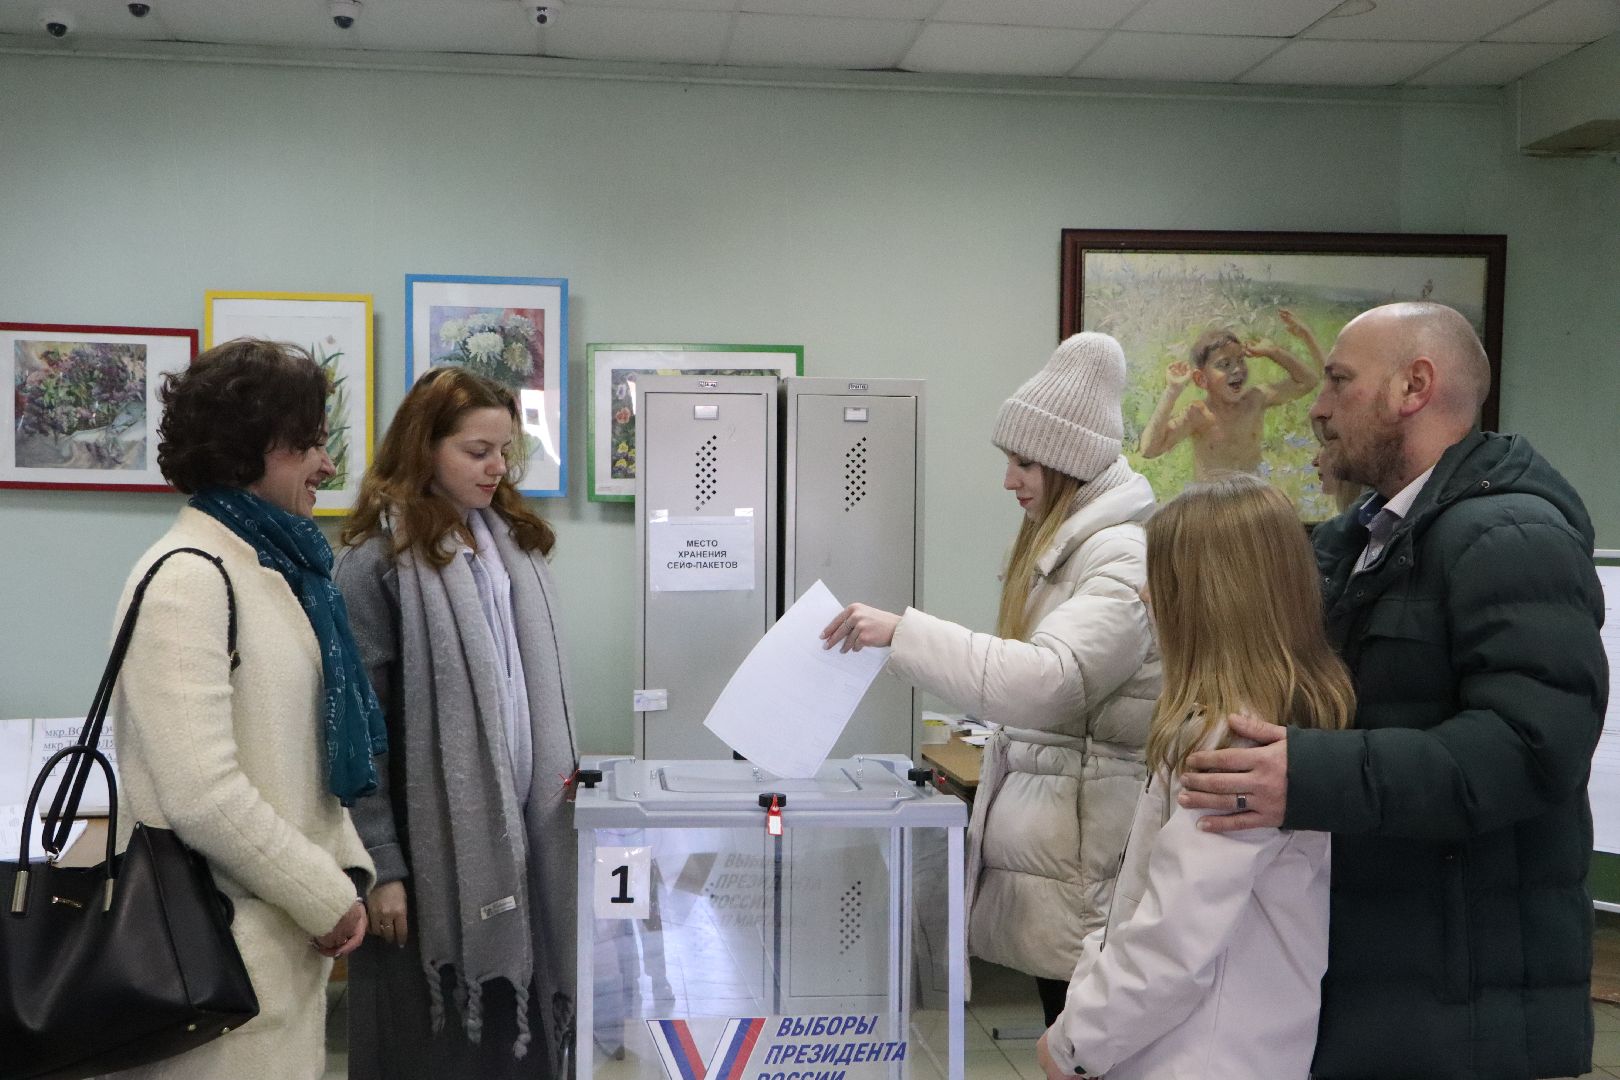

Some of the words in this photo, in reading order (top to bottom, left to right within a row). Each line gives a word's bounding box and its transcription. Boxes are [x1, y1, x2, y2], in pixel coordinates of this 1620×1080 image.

[686, 540, 718, 548] МЕСТО
[678, 550, 727, 558] ХРАНЕНИЯ
[666, 560, 738, 569] СЕЙФ-ПАКЕТОВ
[611, 865, 634, 903] 1
[776, 1015, 879, 1037] ВЫБОРЫ
[764, 1042, 907, 1066] ПРЕЗИДЕНТА
